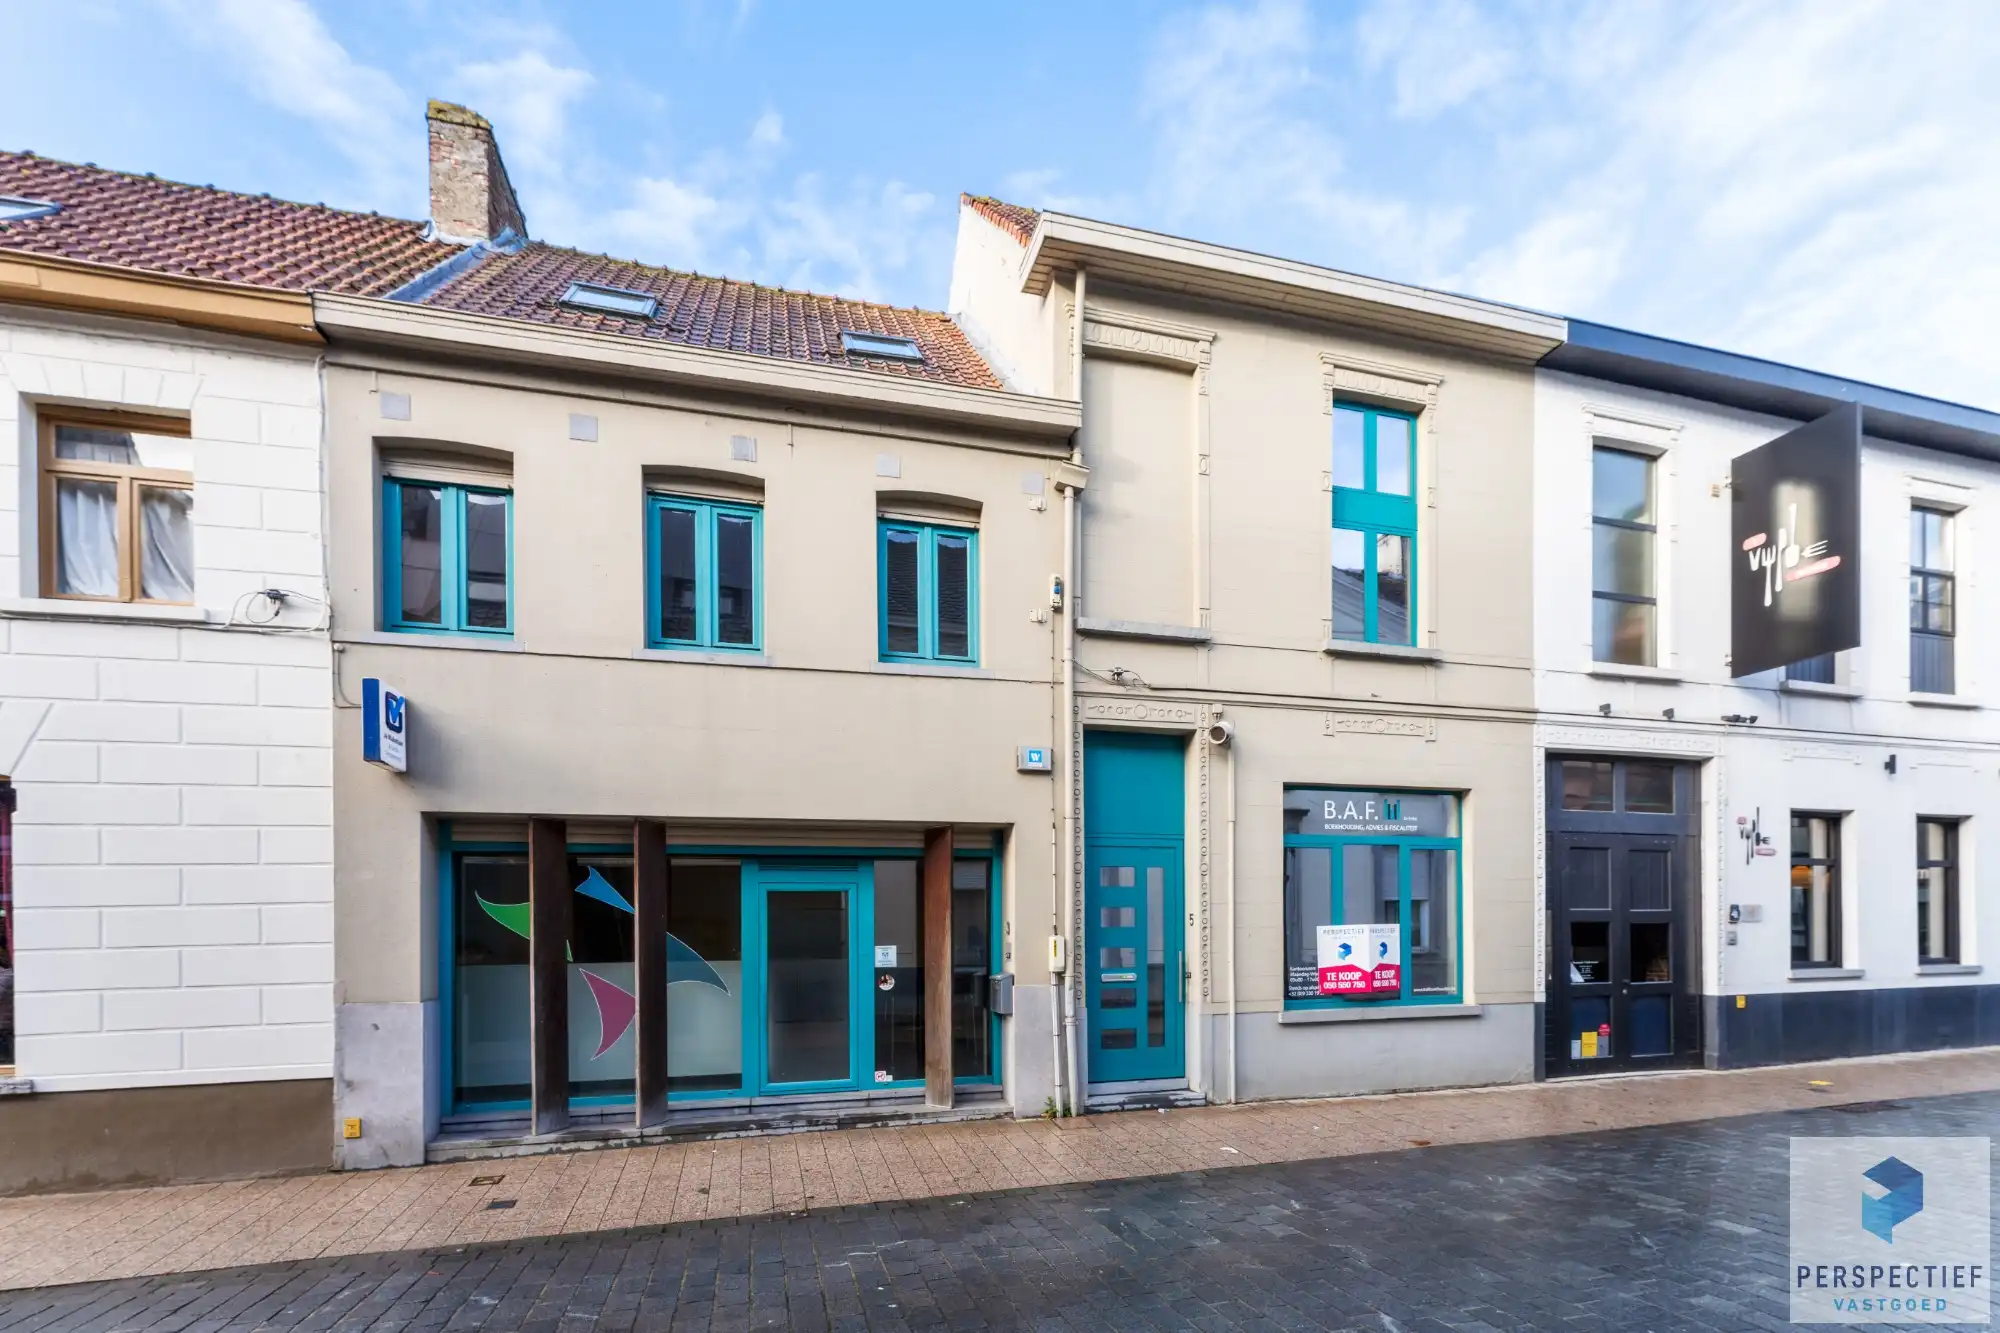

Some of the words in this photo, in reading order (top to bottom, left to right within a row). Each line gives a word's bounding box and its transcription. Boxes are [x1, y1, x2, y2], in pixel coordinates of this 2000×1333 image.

[1324, 800, 1379, 821] B.A.F.
[1189, 913, 1195, 927] 5
[1326, 972, 1337, 981] TE
[1338, 971, 1362, 981] KOOP
[1374, 971, 1382, 979] TE
[1381, 970, 1396, 979] KOOP
